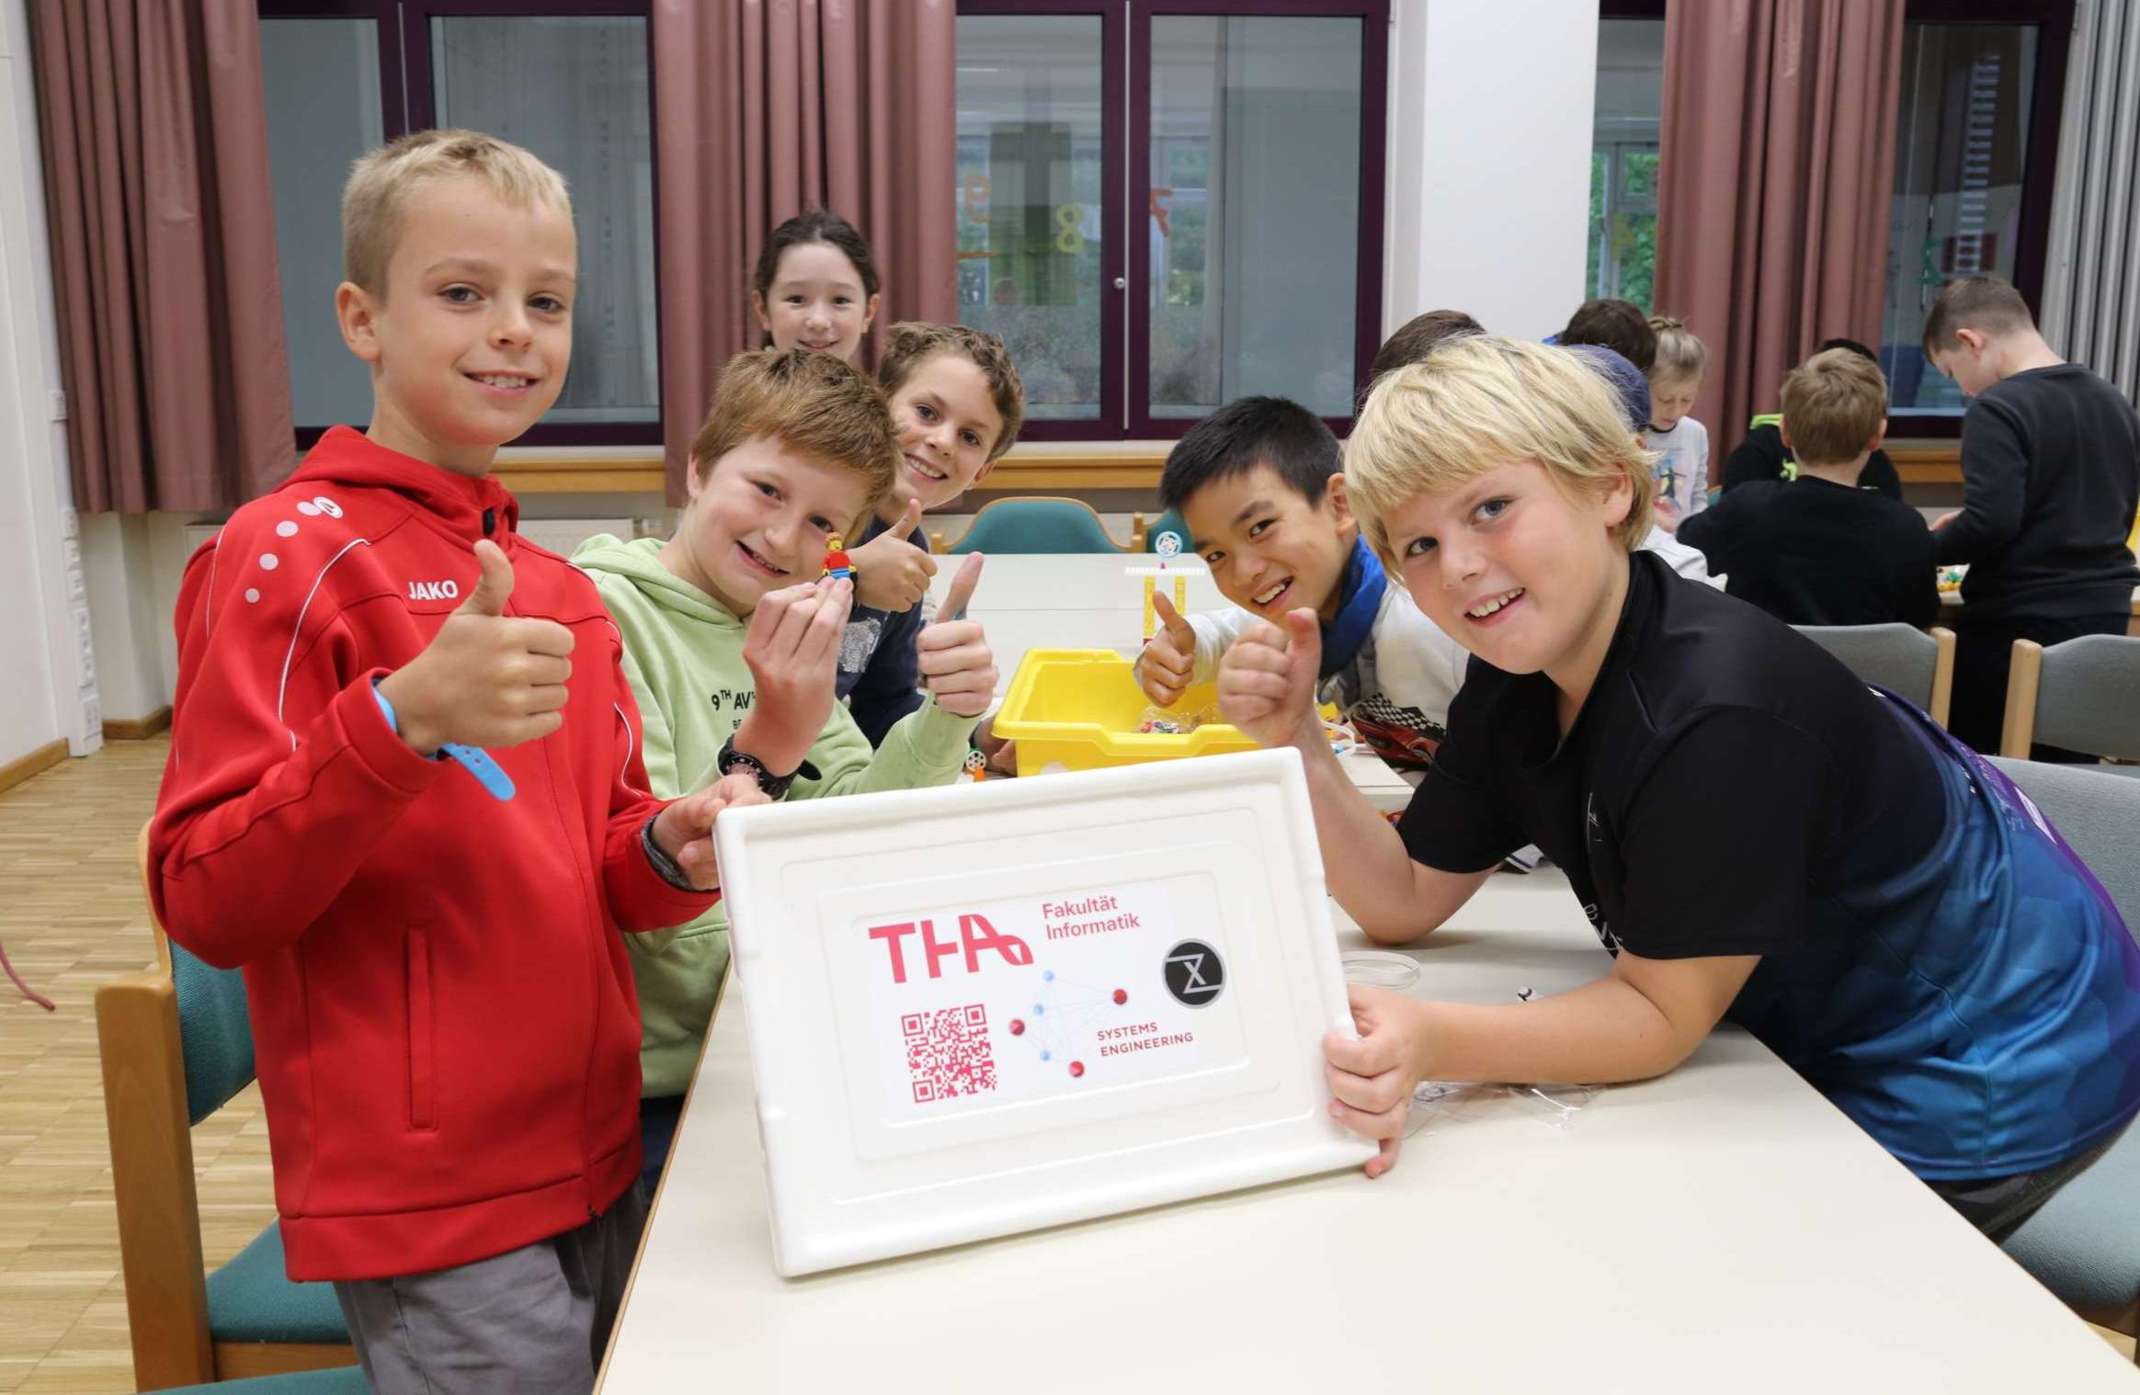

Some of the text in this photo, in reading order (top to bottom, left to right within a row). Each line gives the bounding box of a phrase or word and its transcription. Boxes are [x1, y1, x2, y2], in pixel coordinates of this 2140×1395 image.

[409, 580, 458, 600] JAKO
[1042, 896, 1118, 919] Fakultät
[1046, 913, 1140, 940] Informatik
[868, 914, 1034, 984] THA
[1097, 1022, 1158, 1041] SYSTEMS
[1100, 1032, 1193, 1057] ENGINEERING
